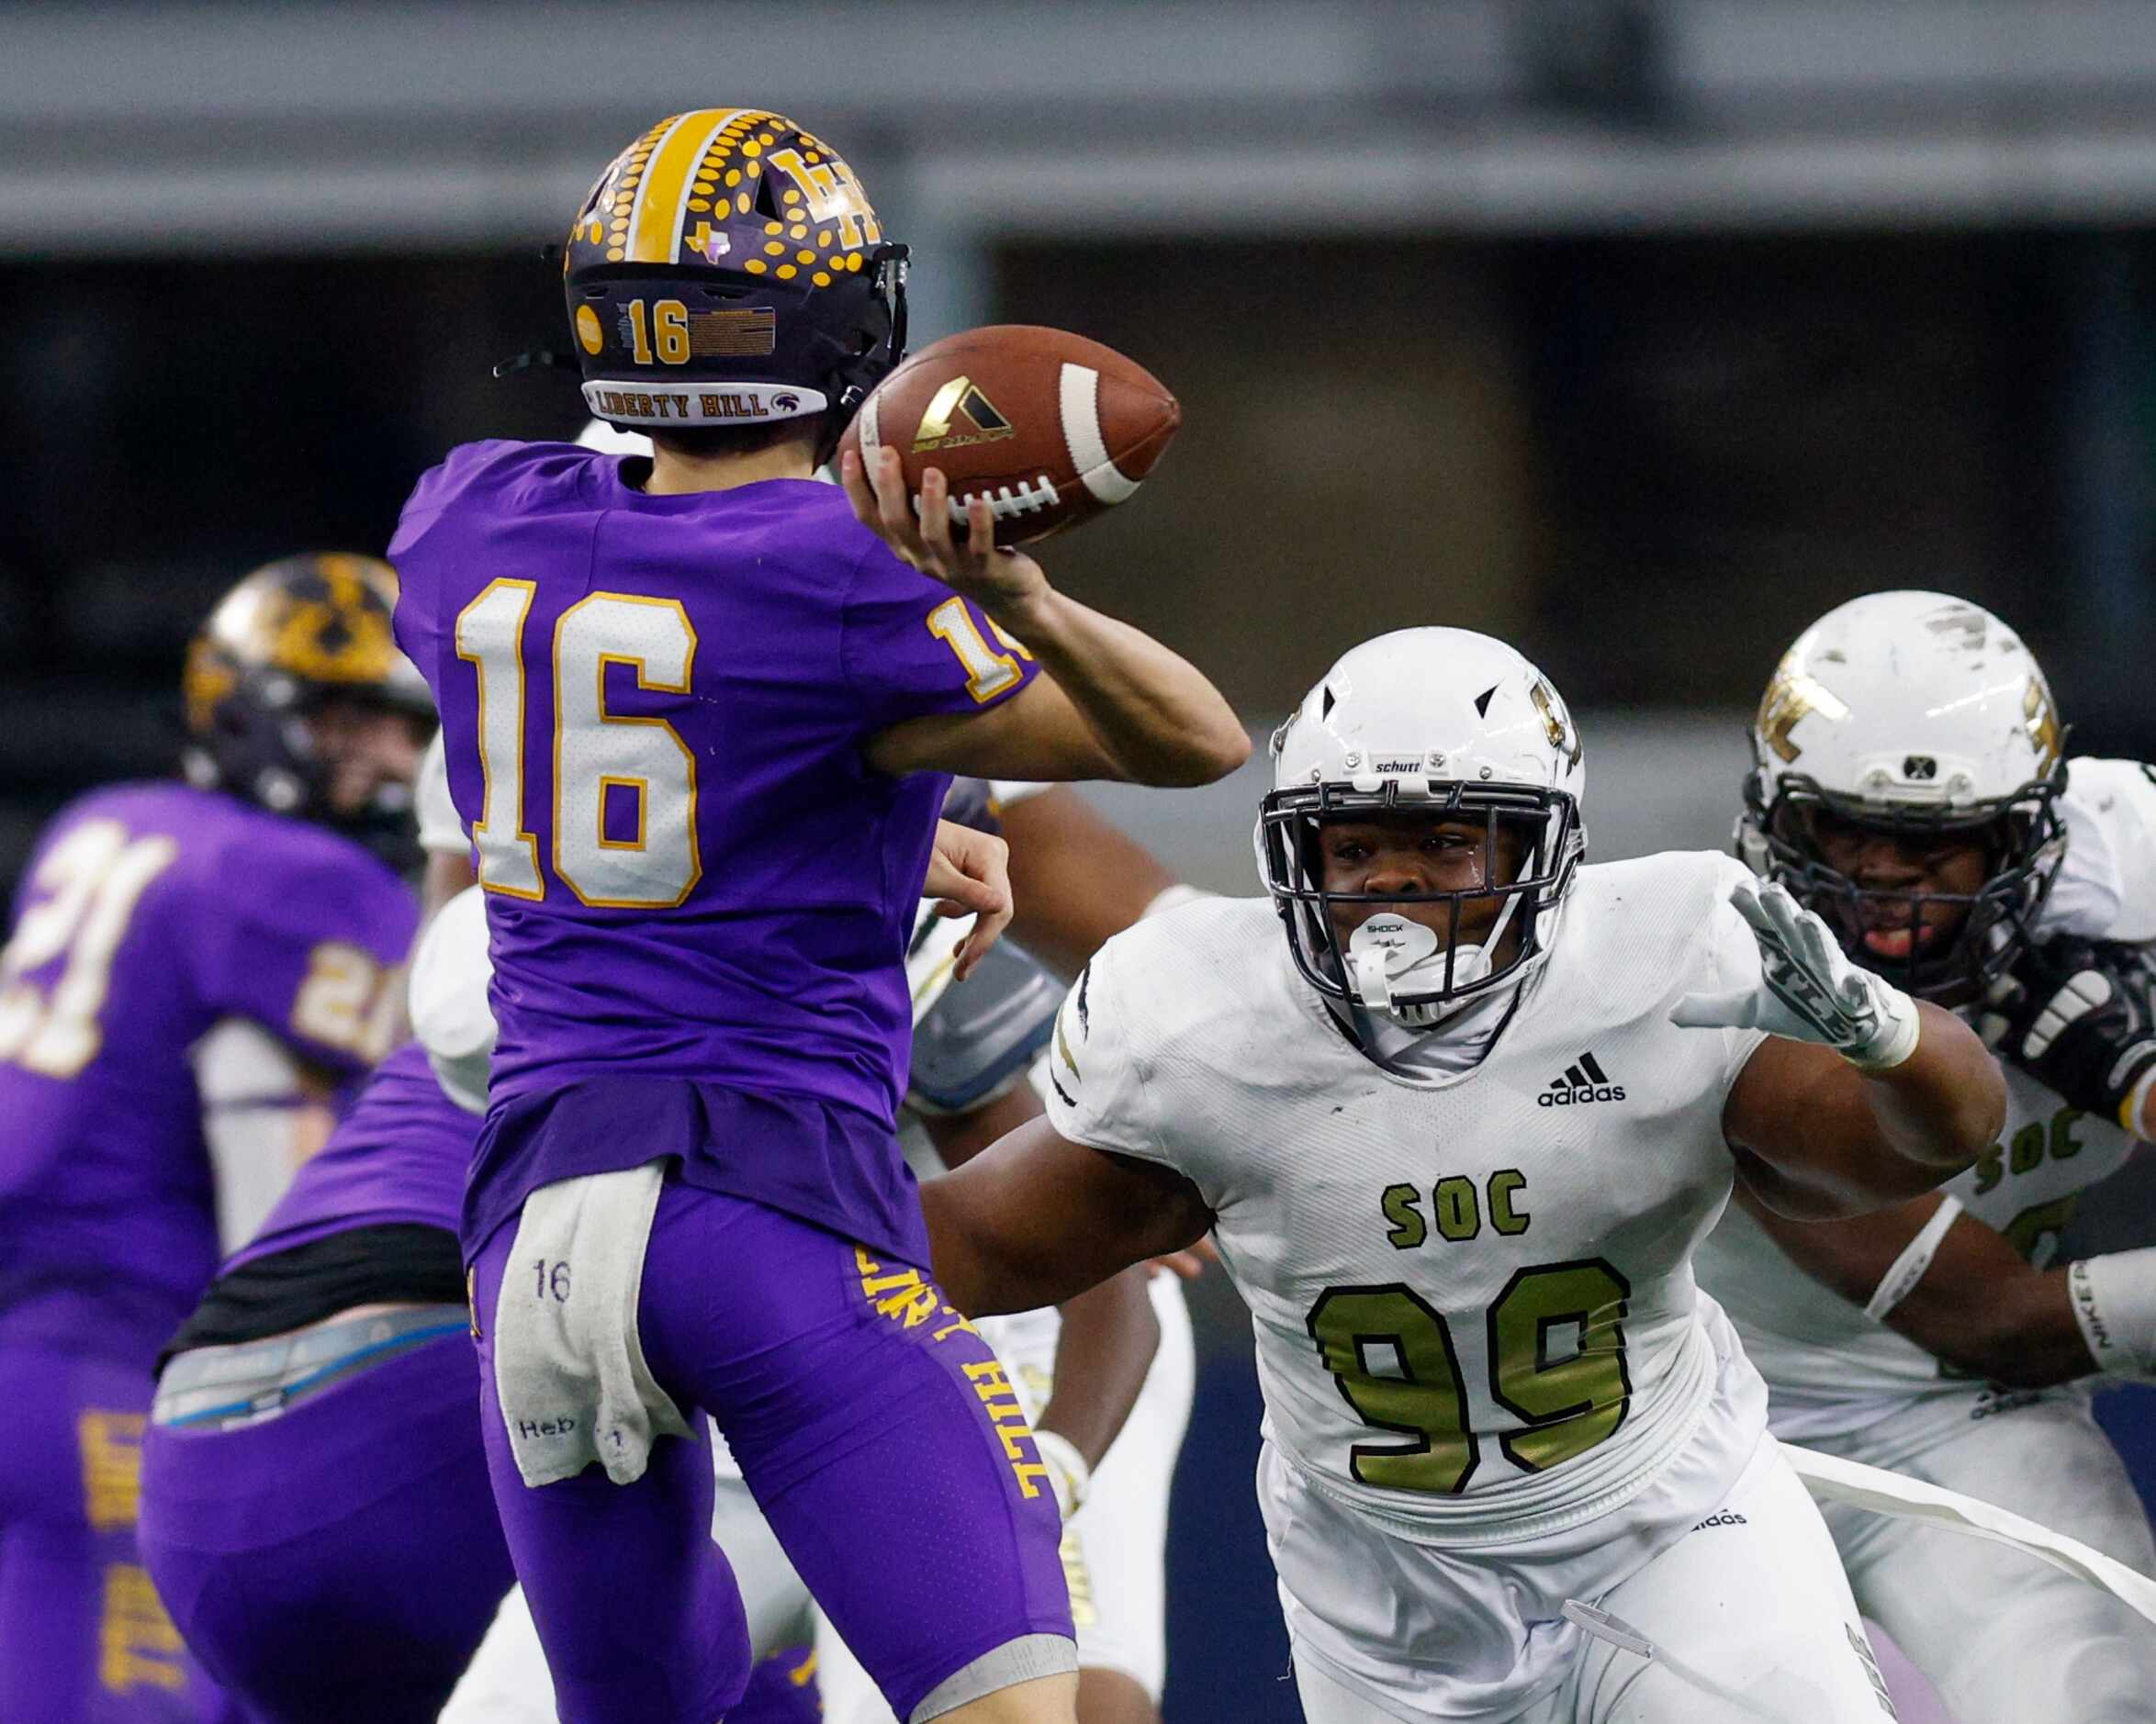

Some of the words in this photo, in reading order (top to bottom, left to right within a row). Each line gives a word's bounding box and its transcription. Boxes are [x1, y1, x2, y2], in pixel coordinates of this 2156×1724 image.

[628, 299, 690, 364] 16
[595, 391, 690, 418] LIBERTY
[699, 394, 769, 417] HILL
[926, 596, 1035, 703] 1
[455, 577, 702, 909] 16
[1376, 761, 1420, 773] schutt
[1366, 924, 1404, 934] SHOCK
[1537, 1081, 1626, 1108] adidas
[1974, 1104, 2085, 1196] SOC
[1380, 1169, 1531, 1249] SOC
[533, 1259, 571, 1304] 16
[2074, 1284, 2113, 1349] NIKE
[1306, 1257, 1632, 1494] 99
[960, 1360, 1049, 1500] HILL
